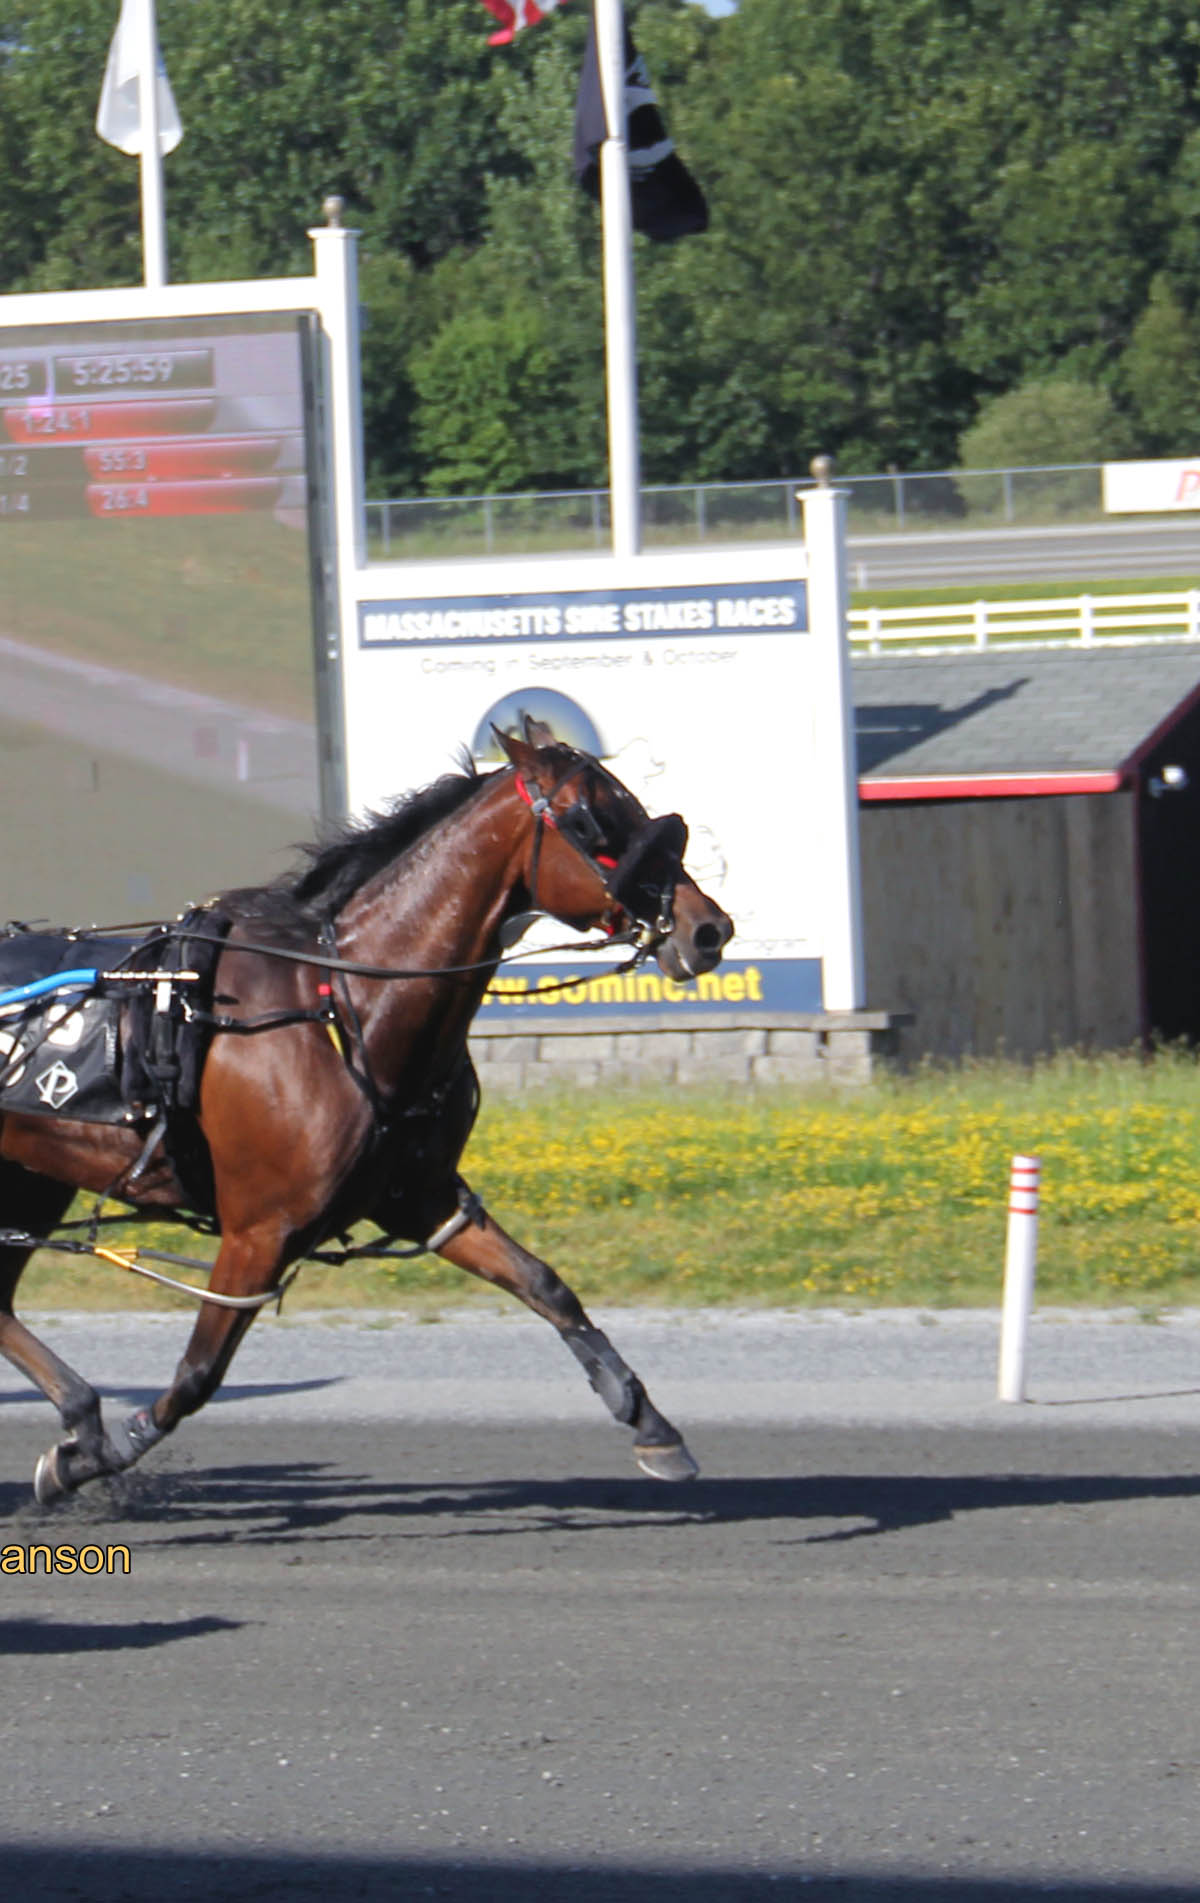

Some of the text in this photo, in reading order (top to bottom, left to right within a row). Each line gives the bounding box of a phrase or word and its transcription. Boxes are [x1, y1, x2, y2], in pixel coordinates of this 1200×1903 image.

[72, 357, 175, 387] 5:25:59
[0, 493, 30, 514] 1/4
[363, 596, 797, 641] MASSACHUSETTS SIRE STAKES RACES
[421, 656, 497, 677] Coming
[528, 650, 633, 674] September
[662, 646, 739, 667] October
